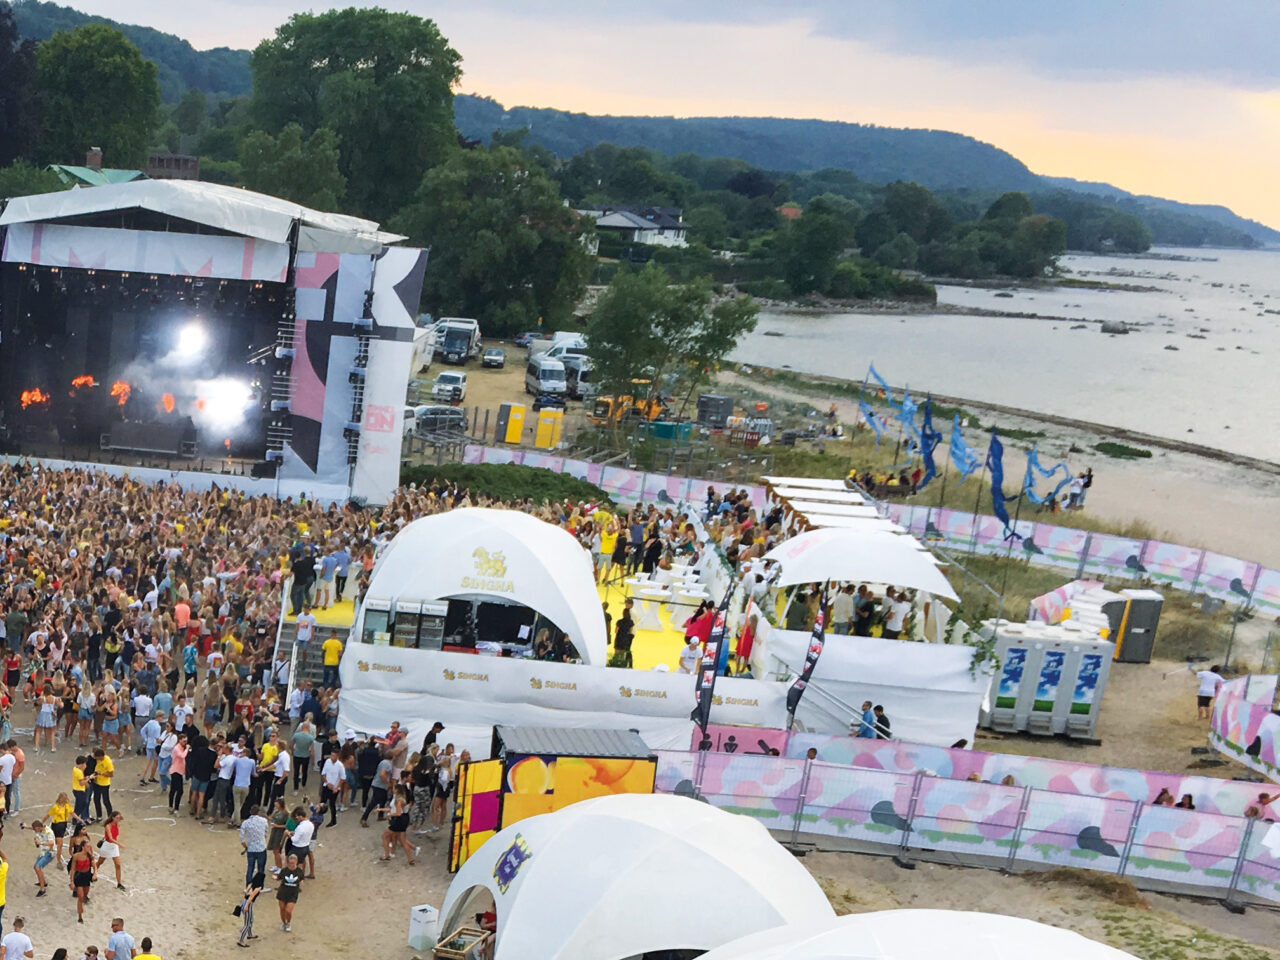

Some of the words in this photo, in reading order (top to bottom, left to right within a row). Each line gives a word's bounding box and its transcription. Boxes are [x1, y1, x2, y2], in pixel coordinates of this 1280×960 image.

[460, 576, 515, 593] SINGHA
[371, 663, 403, 674] SINGHA
[457, 671, 489, 682] SINGHA
[544, 680, 577, 691] SINGHA
[634, 688, 667, 699] SINGHA
[725, 696, 759, 707] SINGHA
